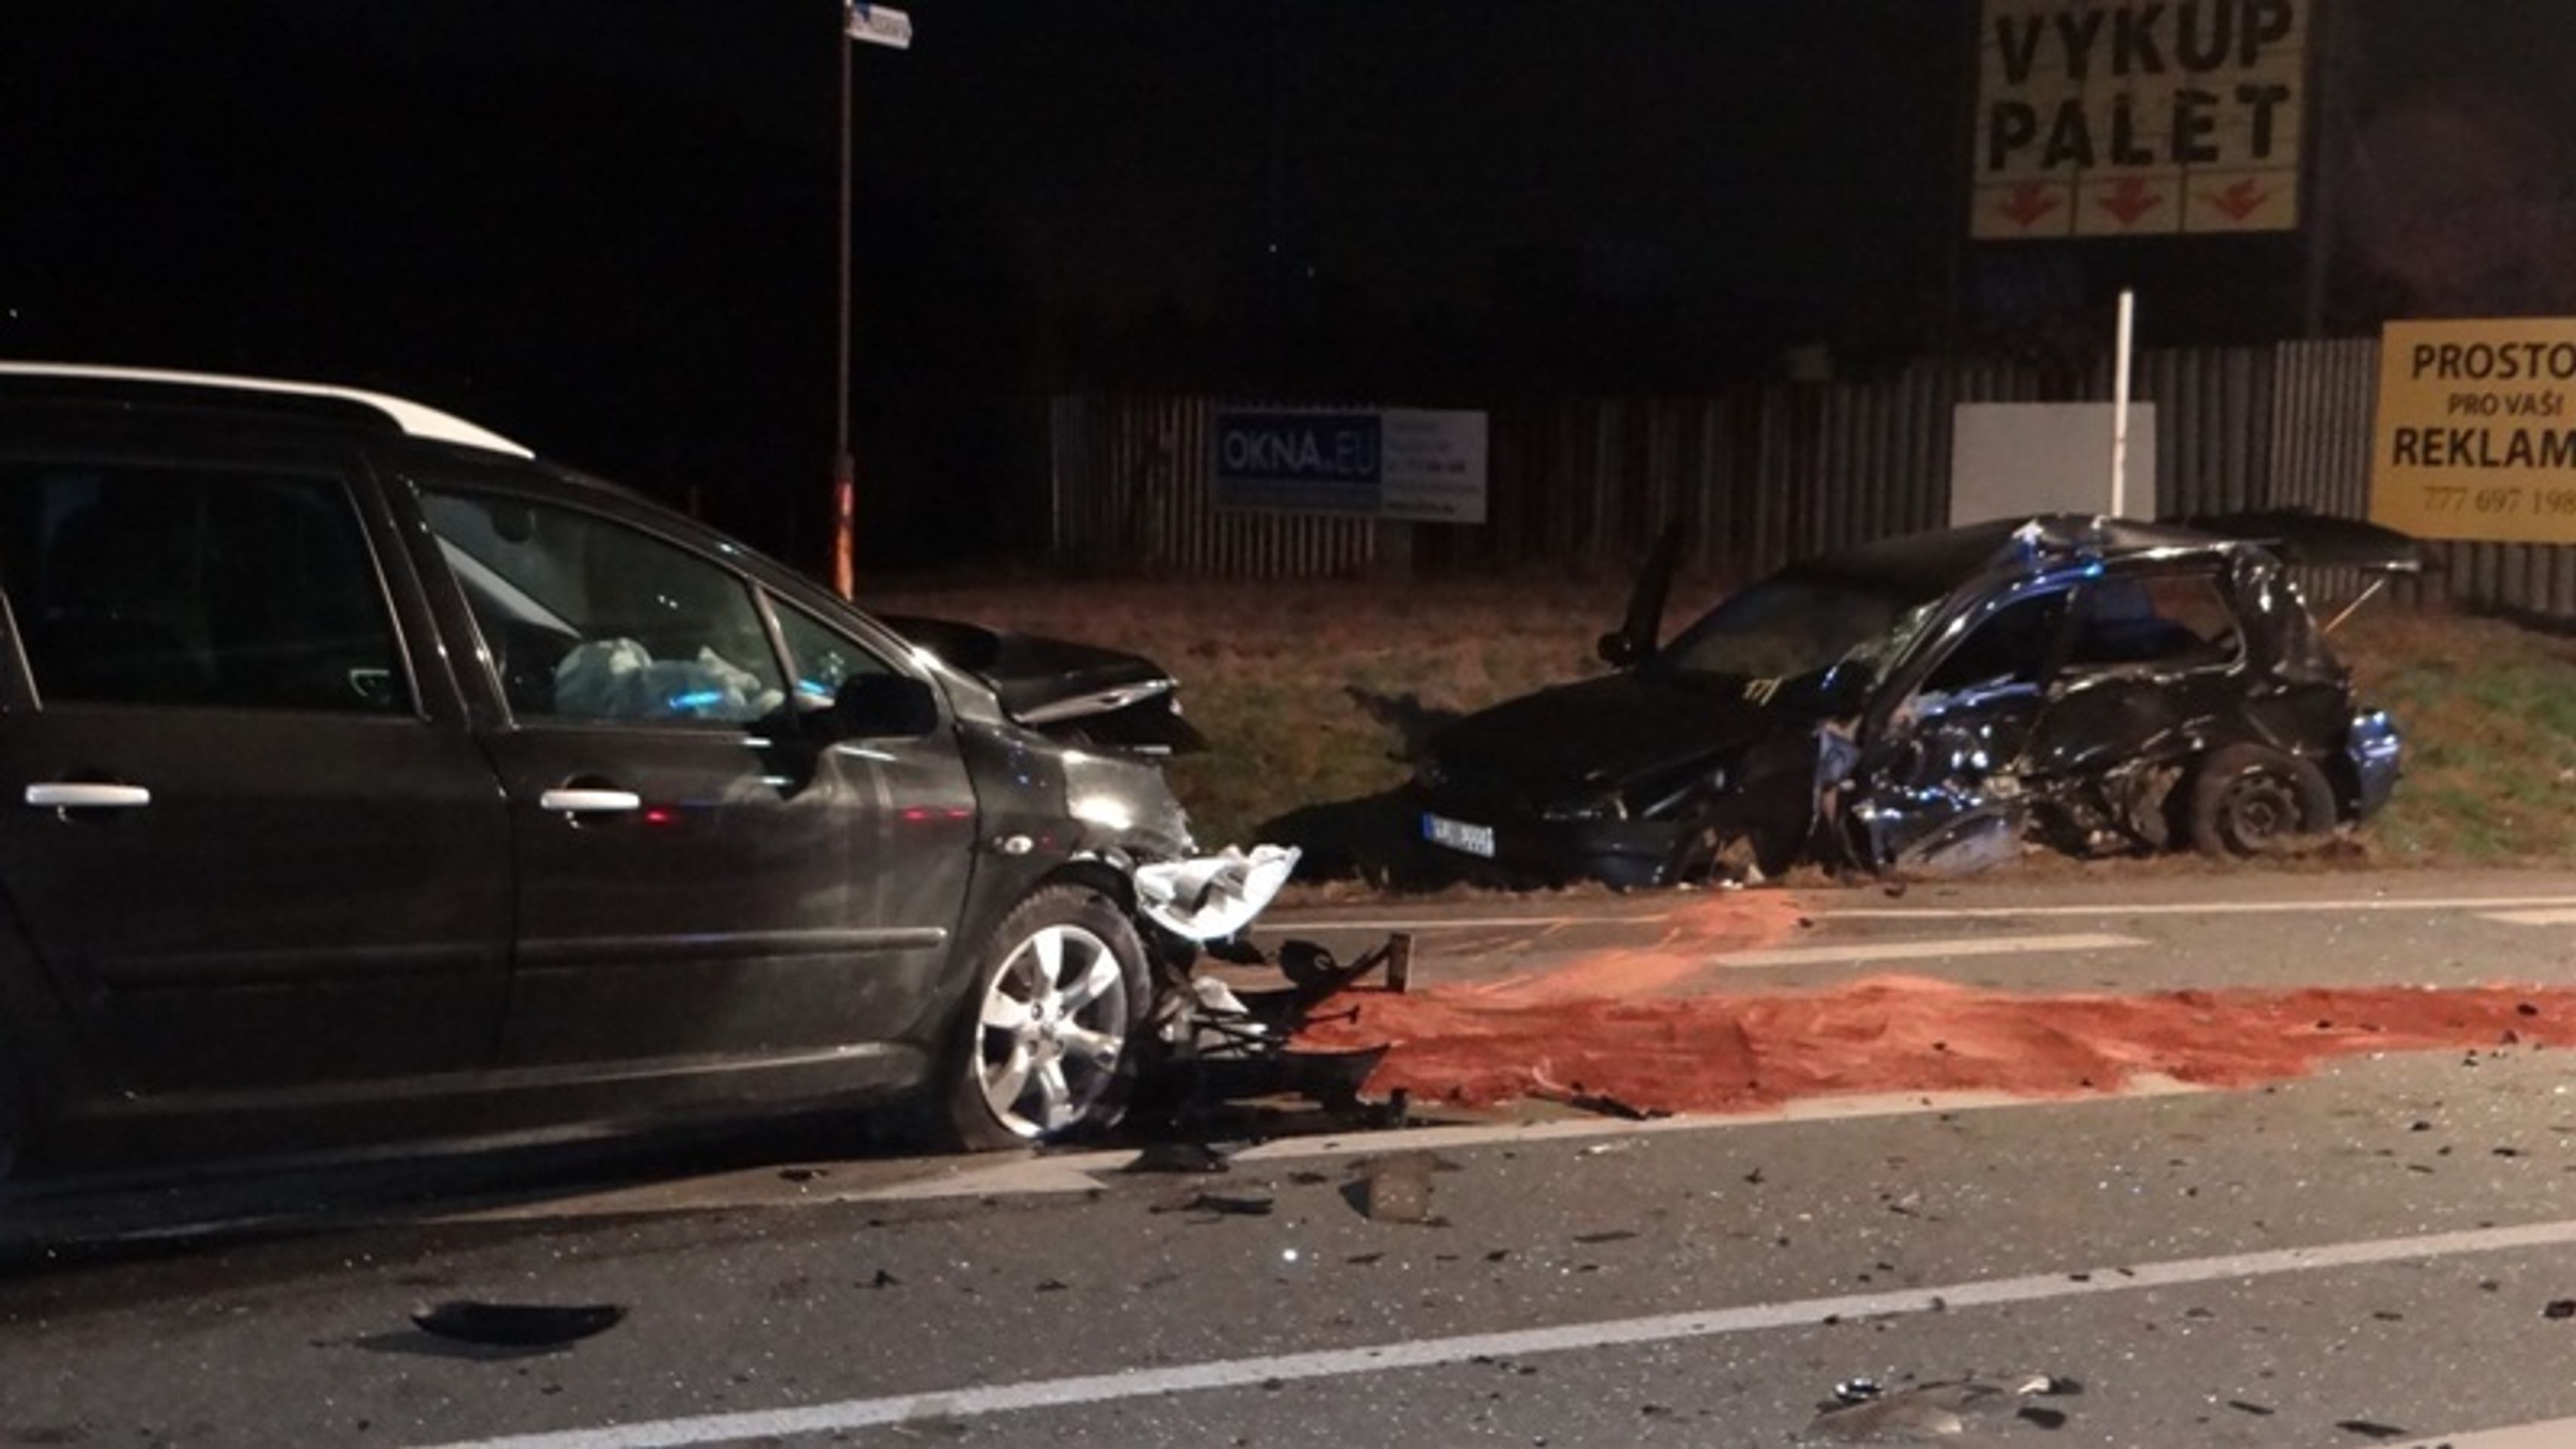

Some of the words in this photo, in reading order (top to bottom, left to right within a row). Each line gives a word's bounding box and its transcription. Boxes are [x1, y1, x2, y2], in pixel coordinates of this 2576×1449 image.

[1996, 0, 2294, 84] VYKUP
[1989, 85, 2289, 171] PALET
[2412, 342, 2576, 380] PROSTO
[2448, 392, 2499, 416] PRO
[2505, 385, 2564, 416] VAŠI
[2393, 428, 2576, 468] REKLAM
[2420, 486, 2468, 512] 777
[2476, 487, 2522, 513] 697
